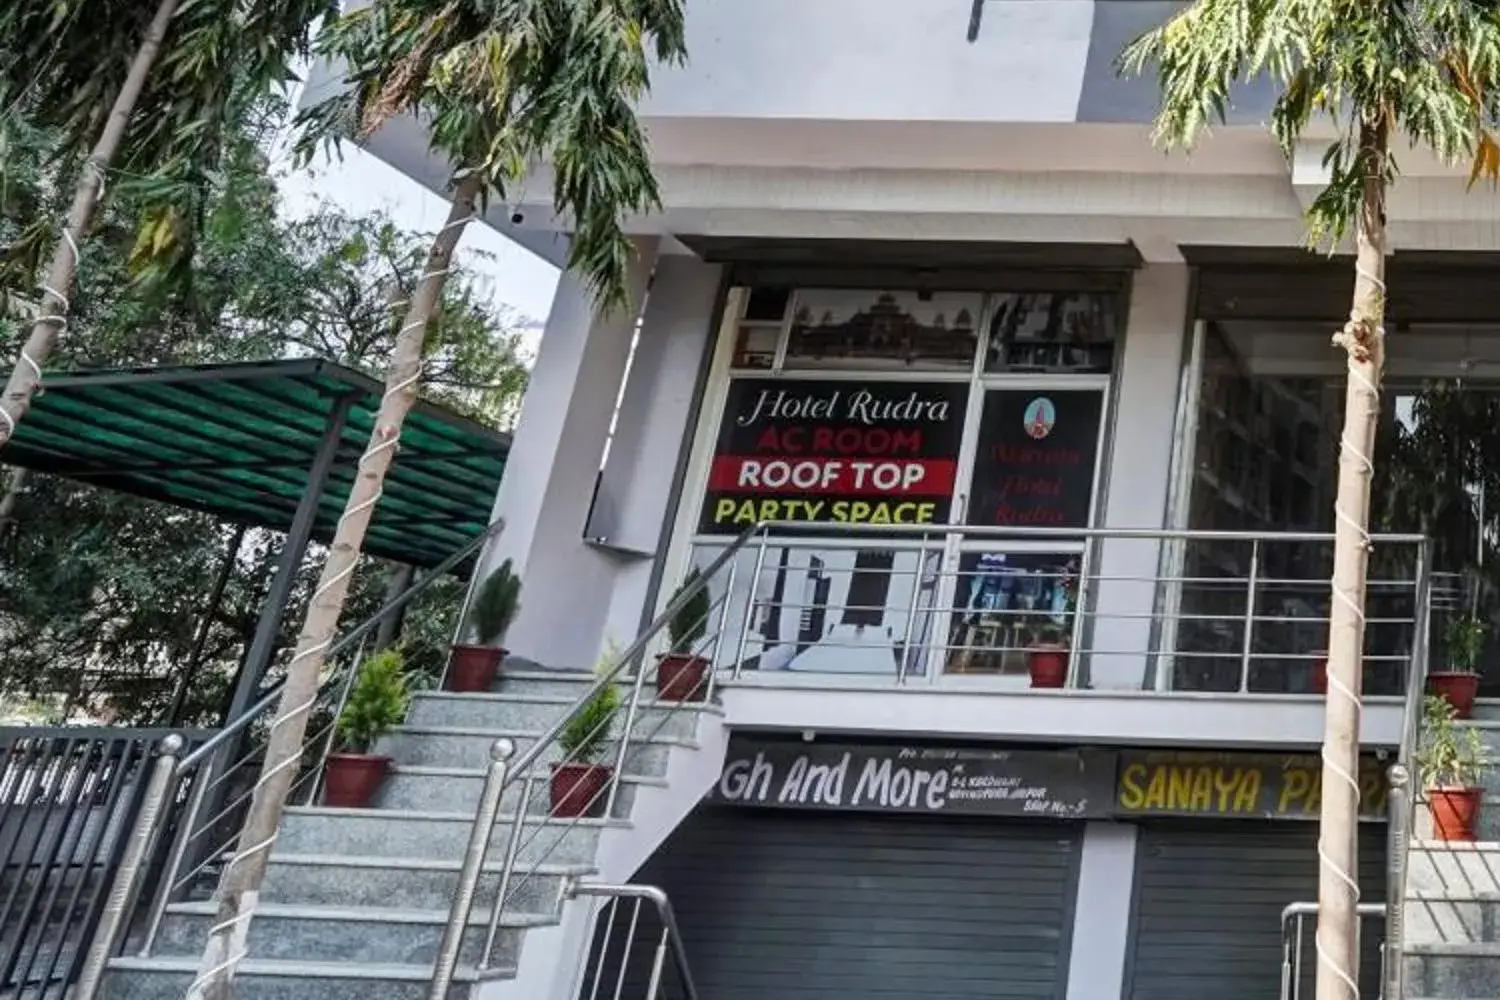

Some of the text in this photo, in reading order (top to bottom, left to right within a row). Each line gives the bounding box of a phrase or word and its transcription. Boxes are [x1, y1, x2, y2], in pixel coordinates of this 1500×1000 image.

[737, 389, 950, 426] Hotel Rudra
[757, 427, 923, 452] AC ROOM
[738, 461, 925, 490] ROOF TOP
[714, 500, 936, 525] PARTY SPACE
[778, 752, 851, 805] And
[850, 757, 949, 810] More
[1120, 763, 1261, 812] SANAYA
